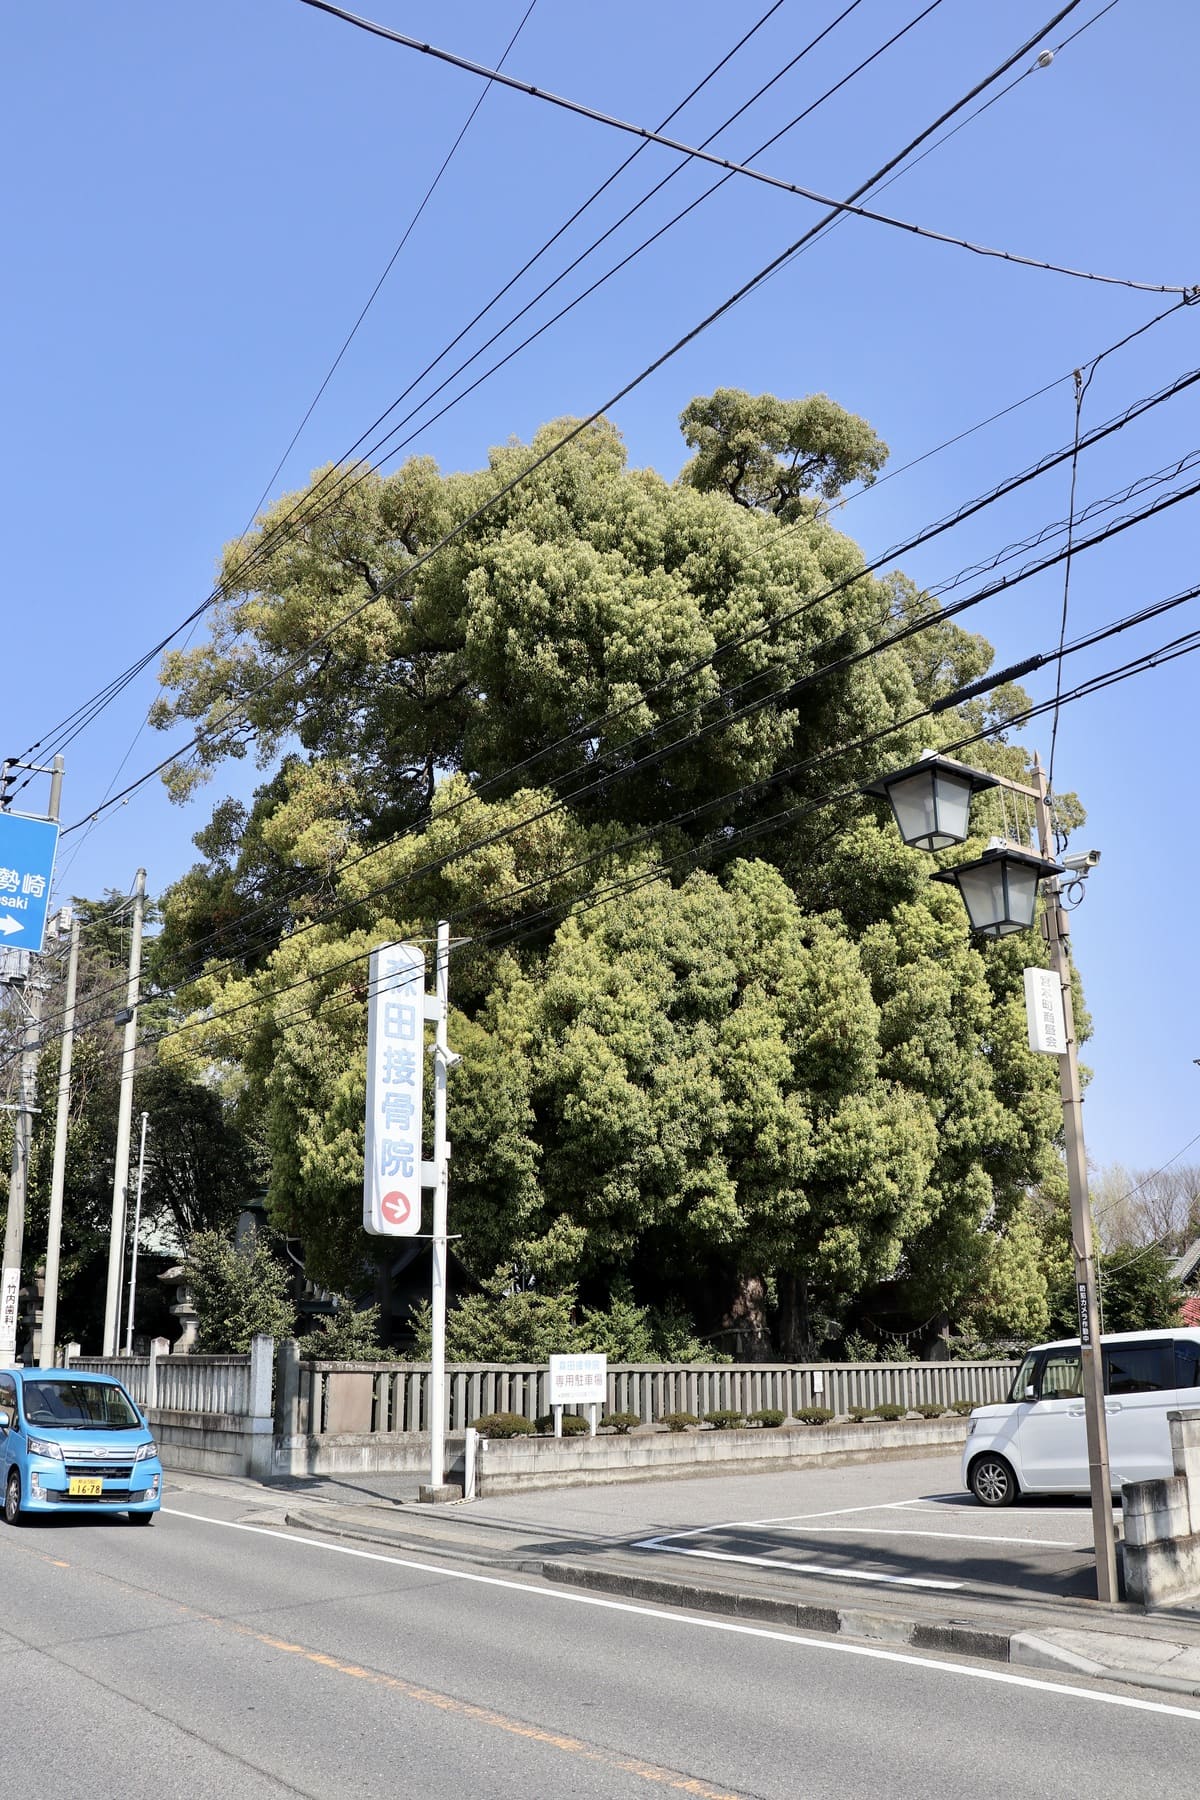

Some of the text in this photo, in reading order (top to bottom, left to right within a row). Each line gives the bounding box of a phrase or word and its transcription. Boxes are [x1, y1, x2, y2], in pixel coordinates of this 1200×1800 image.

[0, 896, 28, 910] saki
[380, 957, 418, 1178] 森田接骨院
[1079, 1285, 1090, 1343] 防犯カメラ作動中
[555, 1374, 602, 1388] 専用駐車場
[77, 1484, 100, 1494] 16-78
